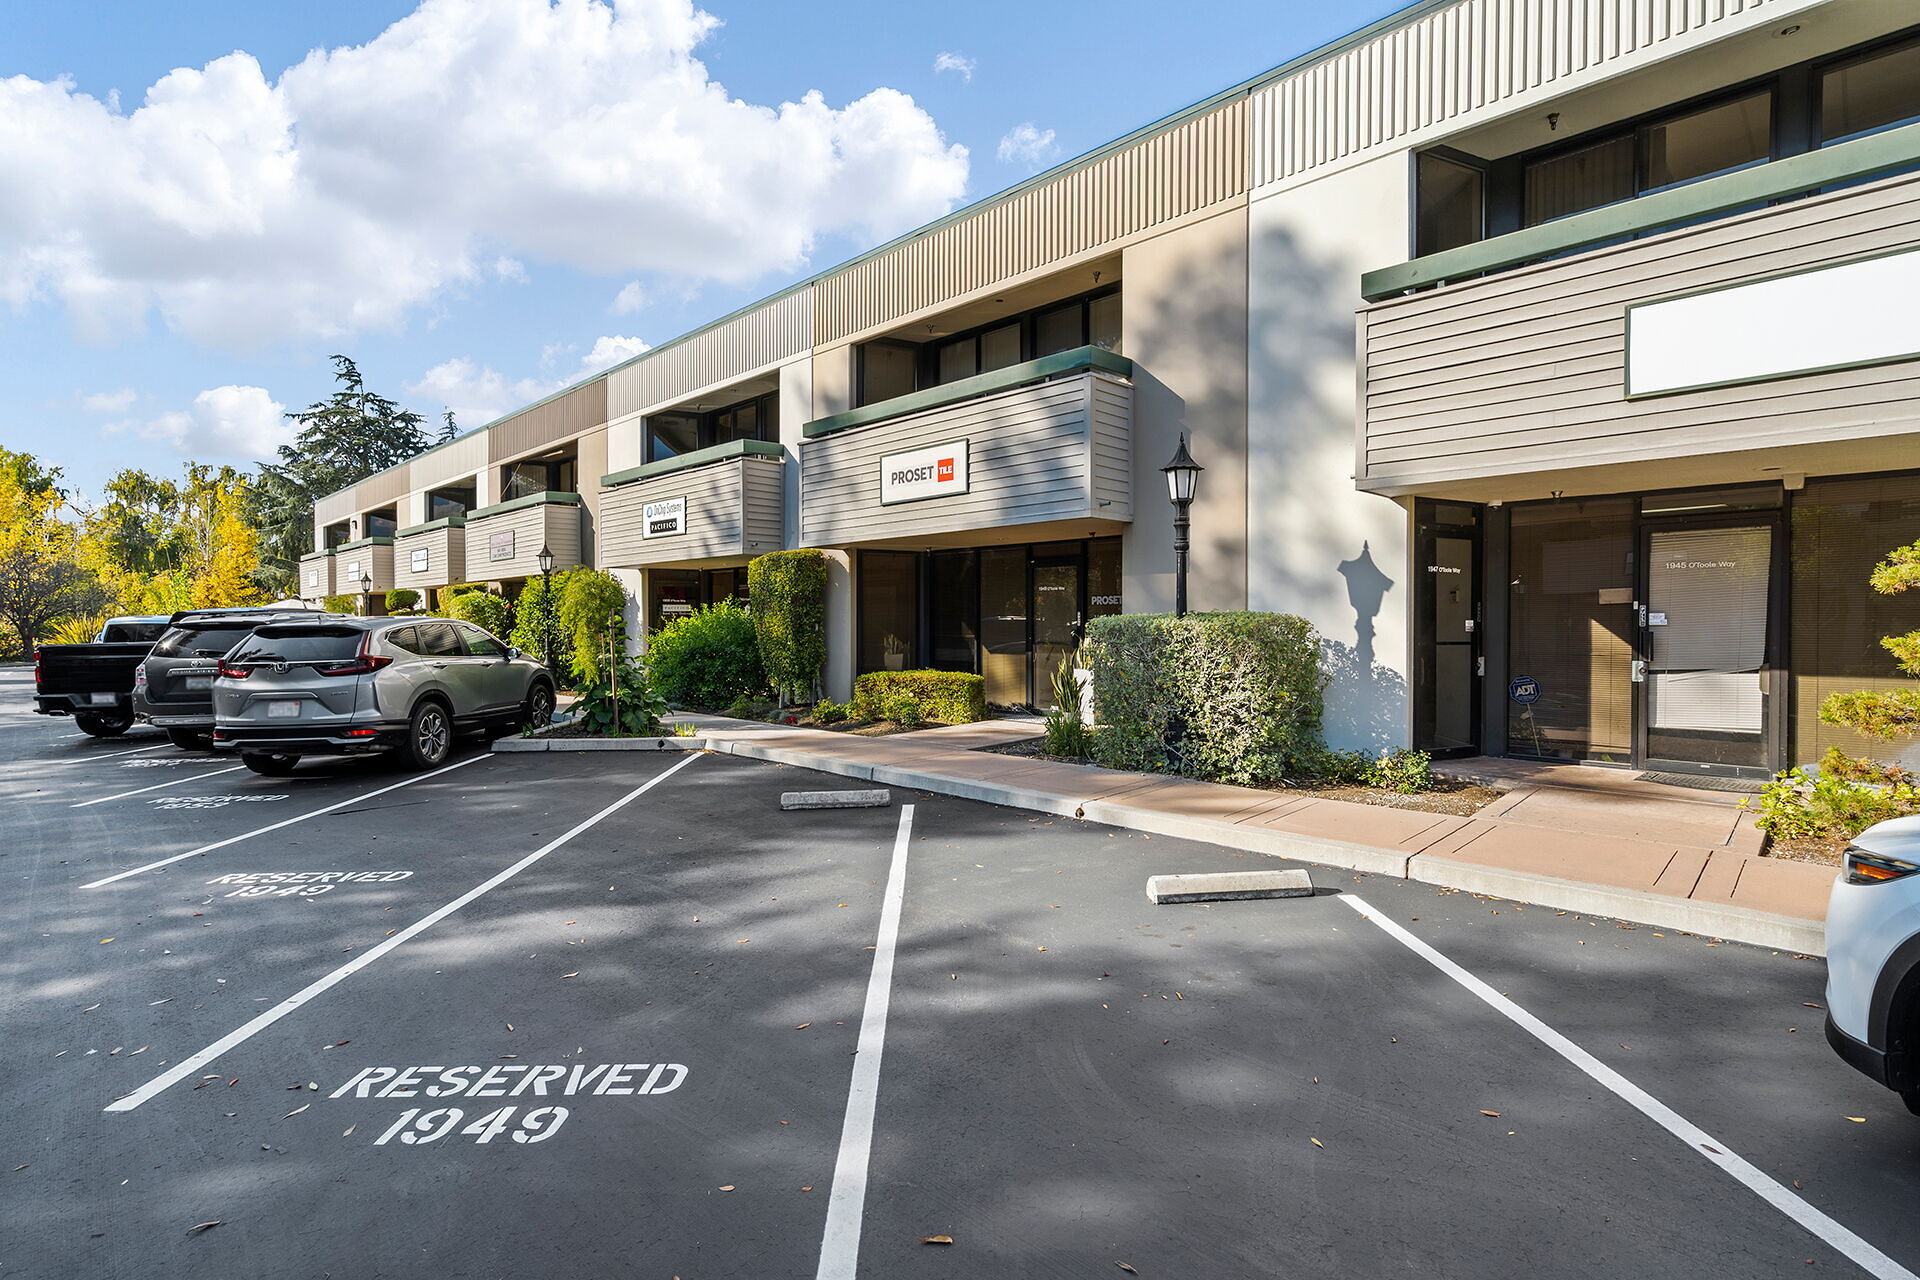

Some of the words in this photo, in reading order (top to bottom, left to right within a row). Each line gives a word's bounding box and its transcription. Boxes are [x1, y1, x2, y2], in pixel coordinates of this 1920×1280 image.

[891, 465, 934, 486] PROSET
[938, 465, 953, 475] TILE
[651, 521, 676, 530] PACIFICO
[1427, 565, 1439, 573] 1947
[1452, 567, 1461, 575] Way
[1688, 561, 1717, 569] O'Toole
[1091, 595, 1122, 605] PROSET
[1516, 684, 1535, 696] ADT
[206, 871, 413, 883] RESERVED
[224, 884, 335, 897] 1949
[328, 1063, 689, 1098] RESERVED
[373, 1106, 570, 1145] 1949
